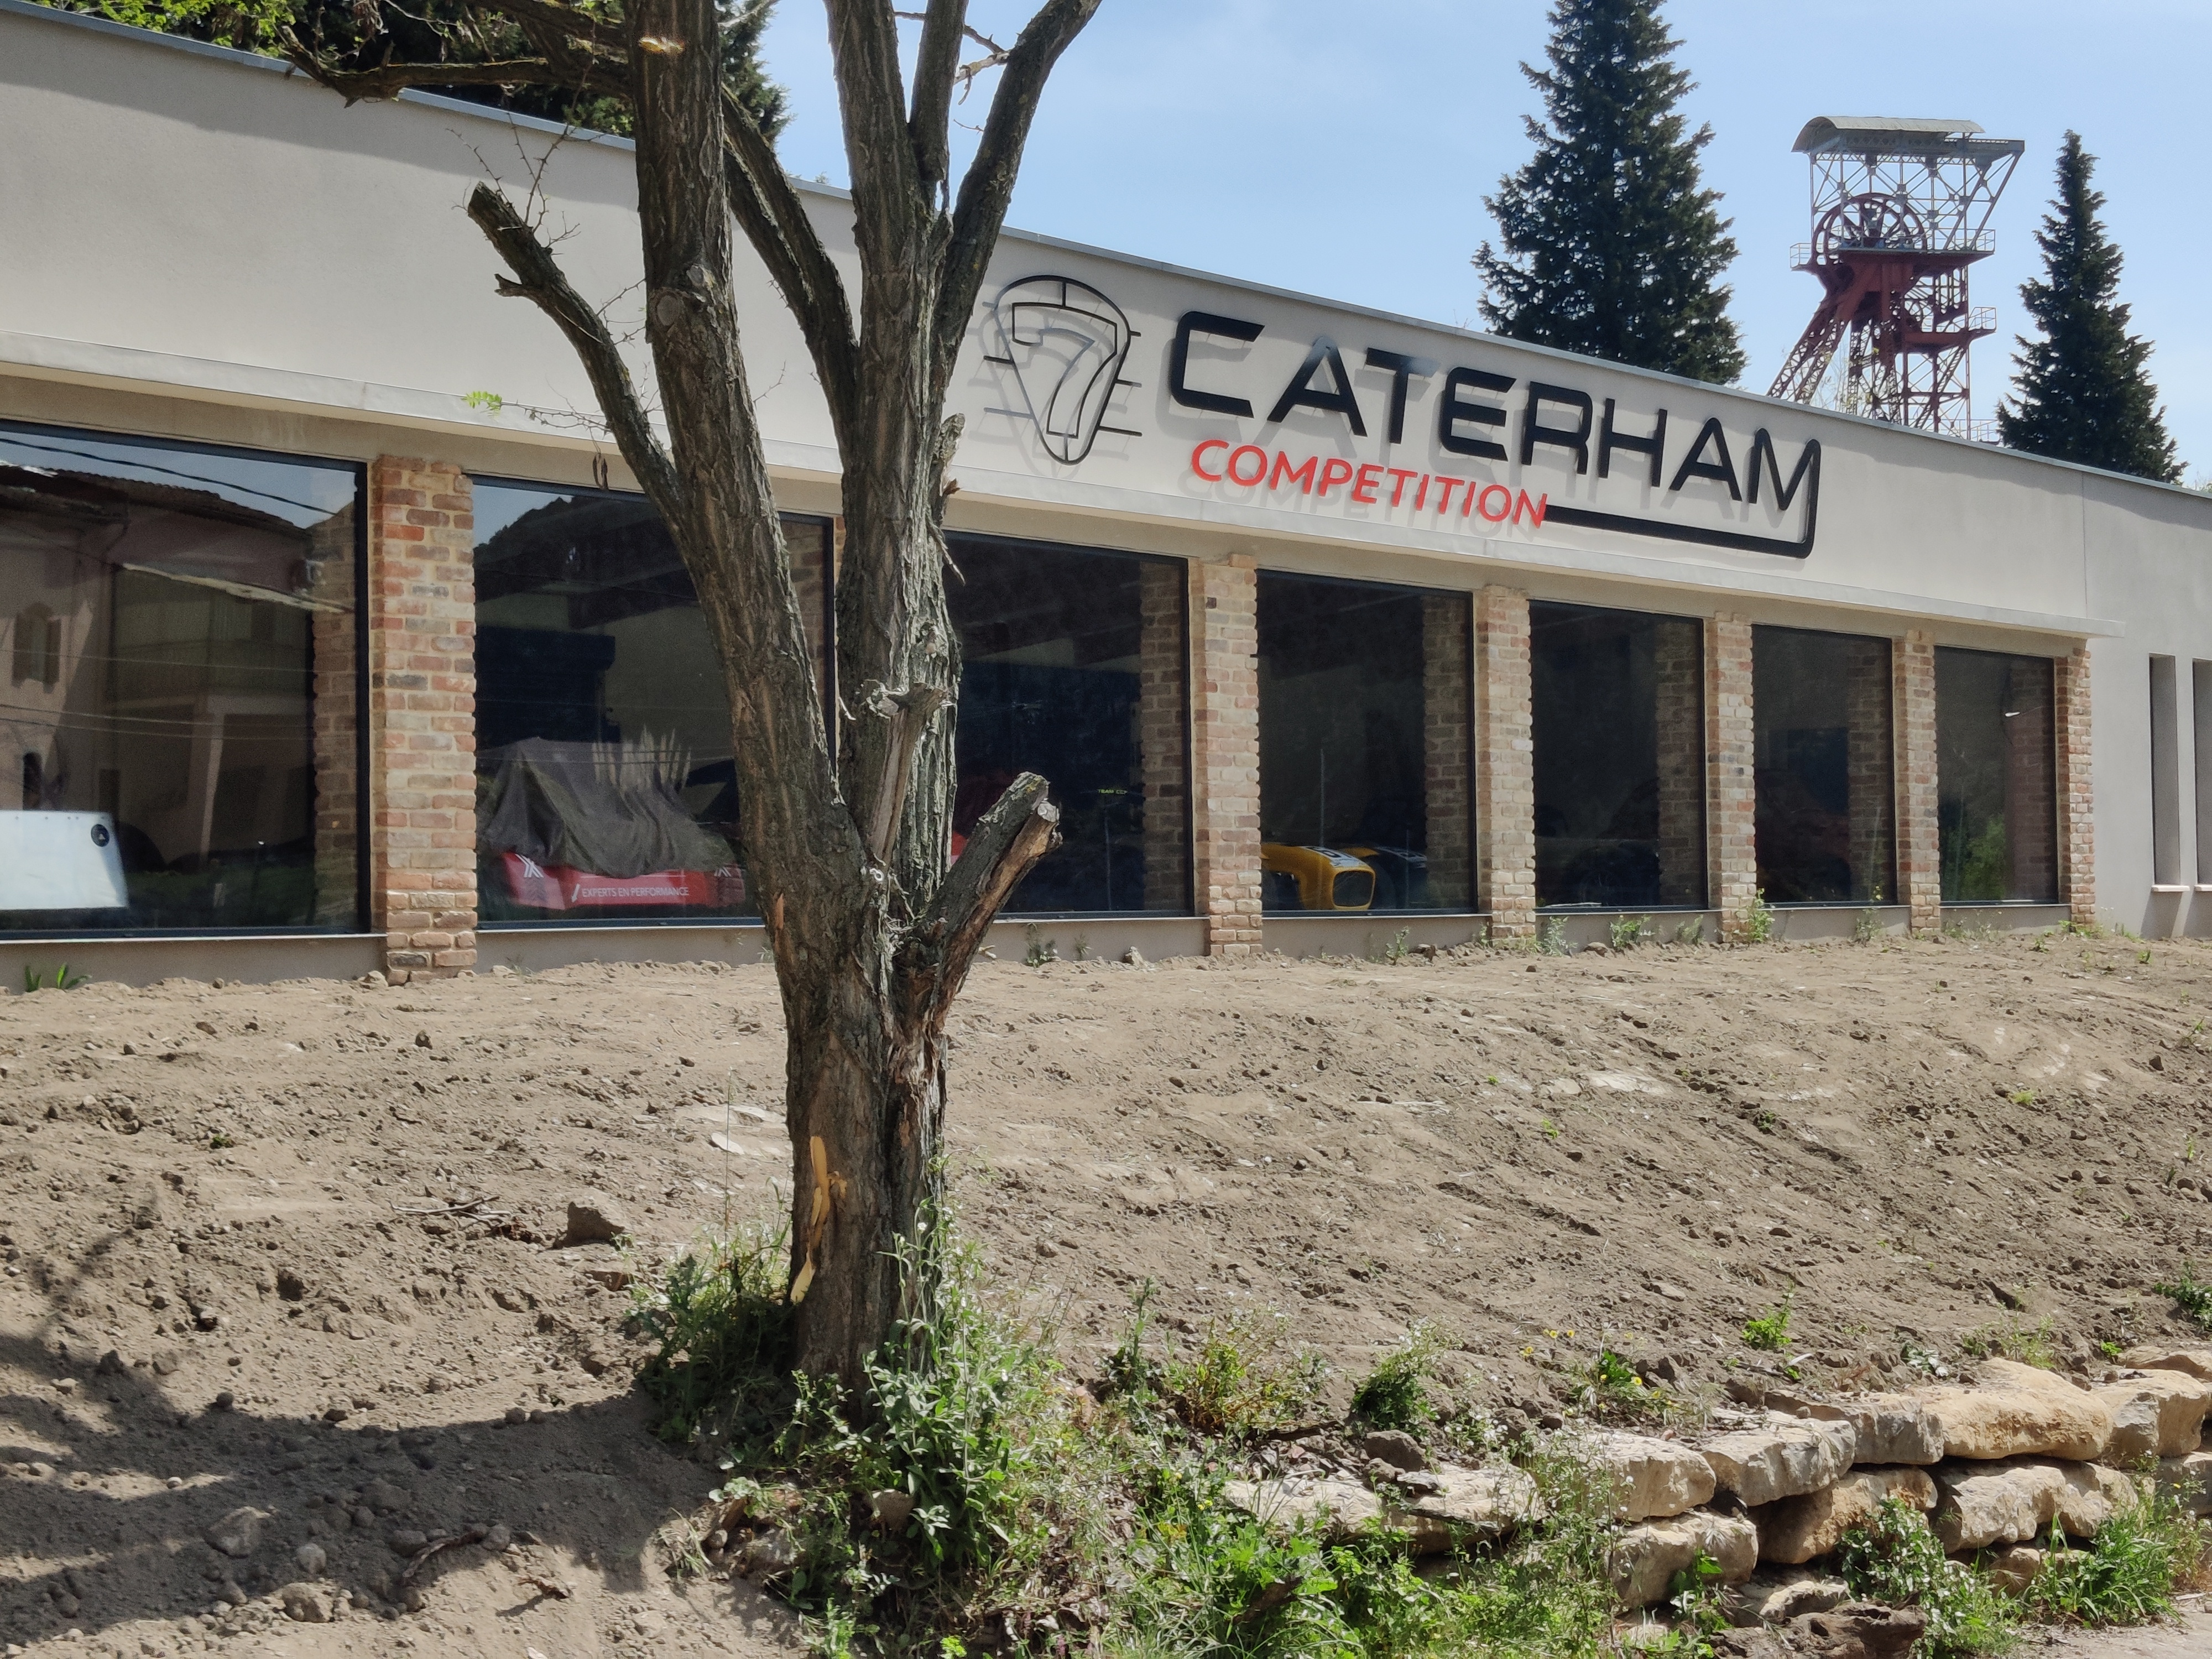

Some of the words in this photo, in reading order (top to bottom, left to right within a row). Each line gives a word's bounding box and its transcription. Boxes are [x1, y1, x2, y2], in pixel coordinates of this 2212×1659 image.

[1169, 310, 1821, 525] CATERHAM
[1191, 439, 1547, 529] COMPETITION
[582, 888, 617, 898] EXPERTS
[618, 888, 630, 897] EN
[631, 886, 690, 897] PERFORMANCE
